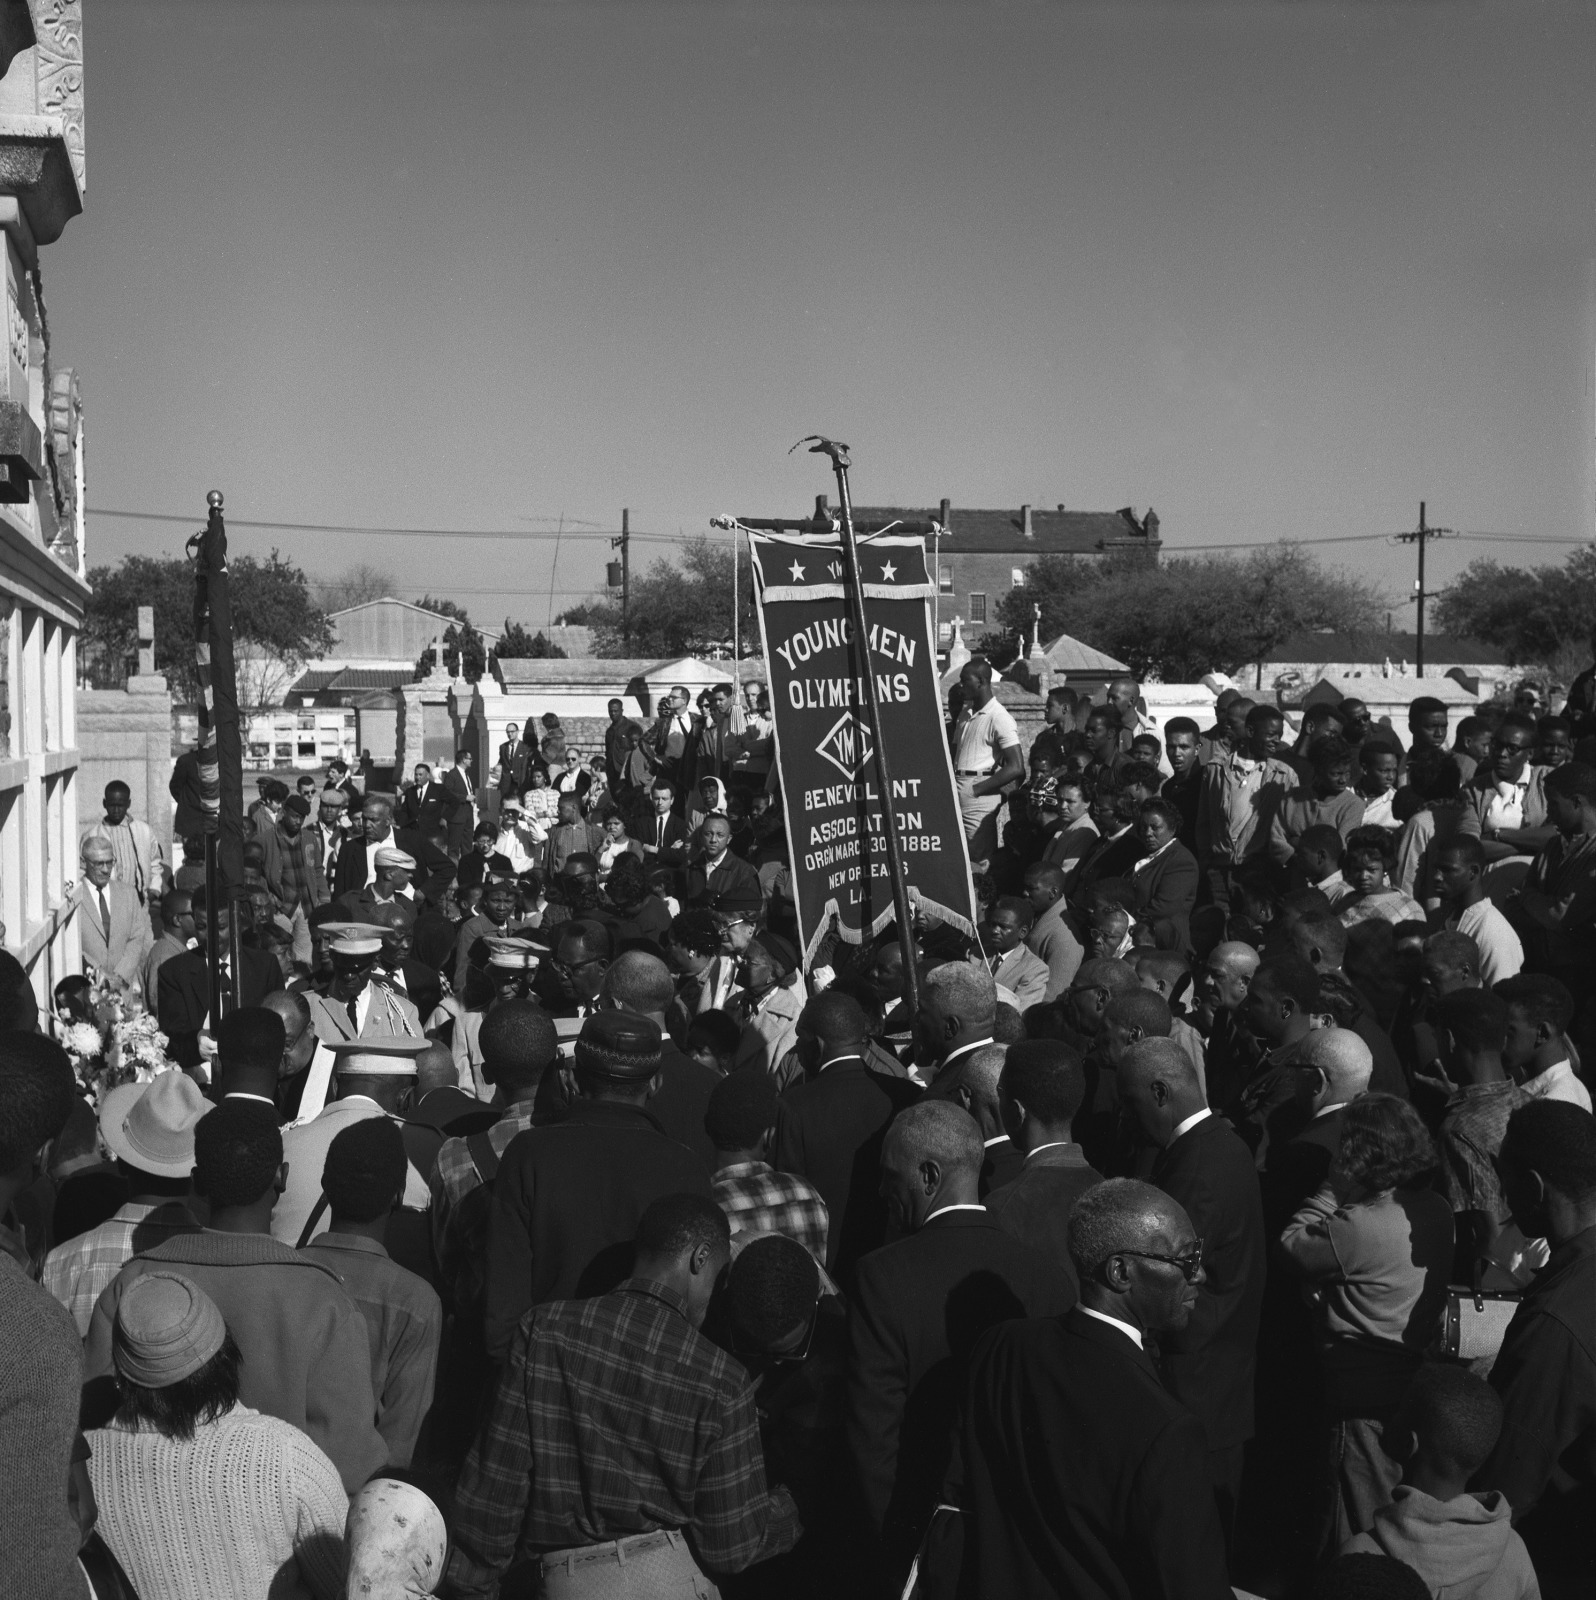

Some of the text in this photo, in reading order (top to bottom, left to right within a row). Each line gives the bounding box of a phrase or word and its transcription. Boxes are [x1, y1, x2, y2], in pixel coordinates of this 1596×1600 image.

[776, 617, 855, 671] YOUNG
[788, 672, 910, 710] OLYMPINS
[805, 779, 921, 811] BENEVOLNT
[810, 812, 922, 846] ASSOCIATON
[835, 838, 869, 862] MARCH
[871, 836, 887, 853] 30
[900, 835, 942, 852] 1882
[828, 861, 909, 891] NEW ORLEAS
